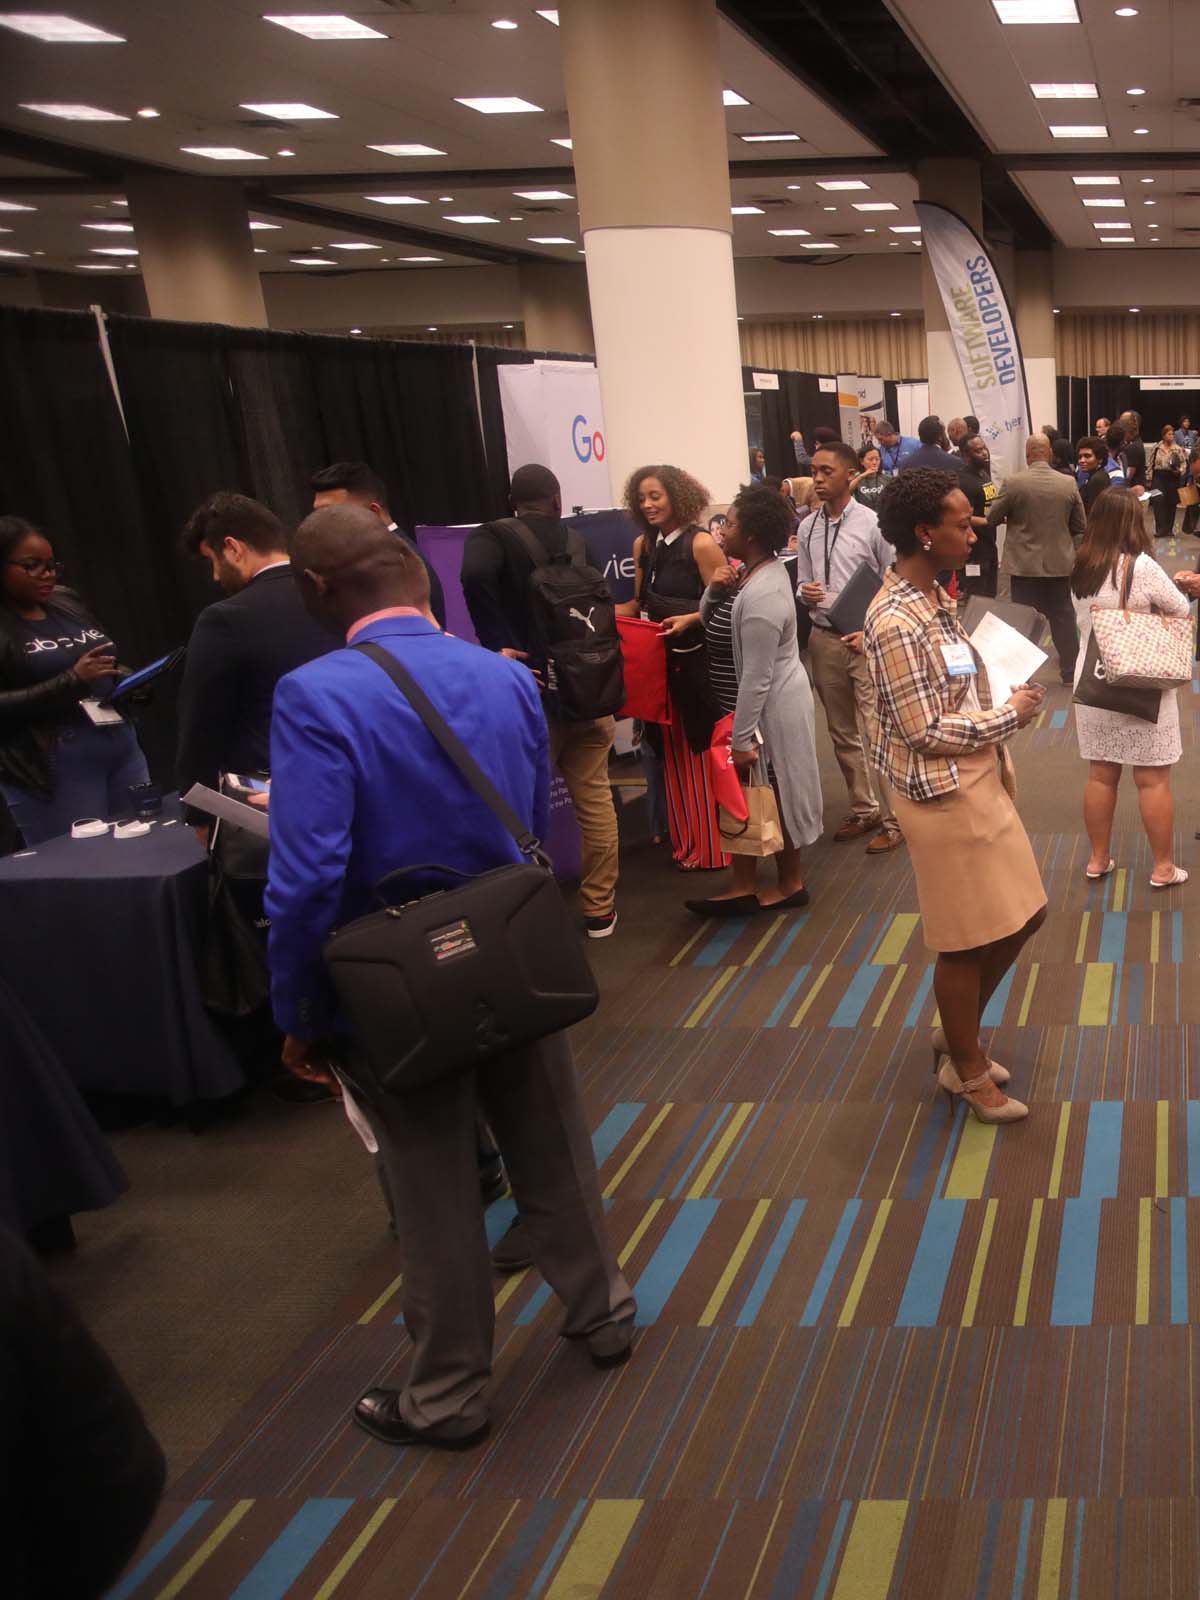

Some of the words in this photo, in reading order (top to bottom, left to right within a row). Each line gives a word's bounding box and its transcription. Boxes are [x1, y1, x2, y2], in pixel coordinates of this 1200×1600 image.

[951, 282, 996, 390] SOFTWARE
[966, 255, 1016, 385] DEVELOPERS
[571, 414, 605, 463] Go
